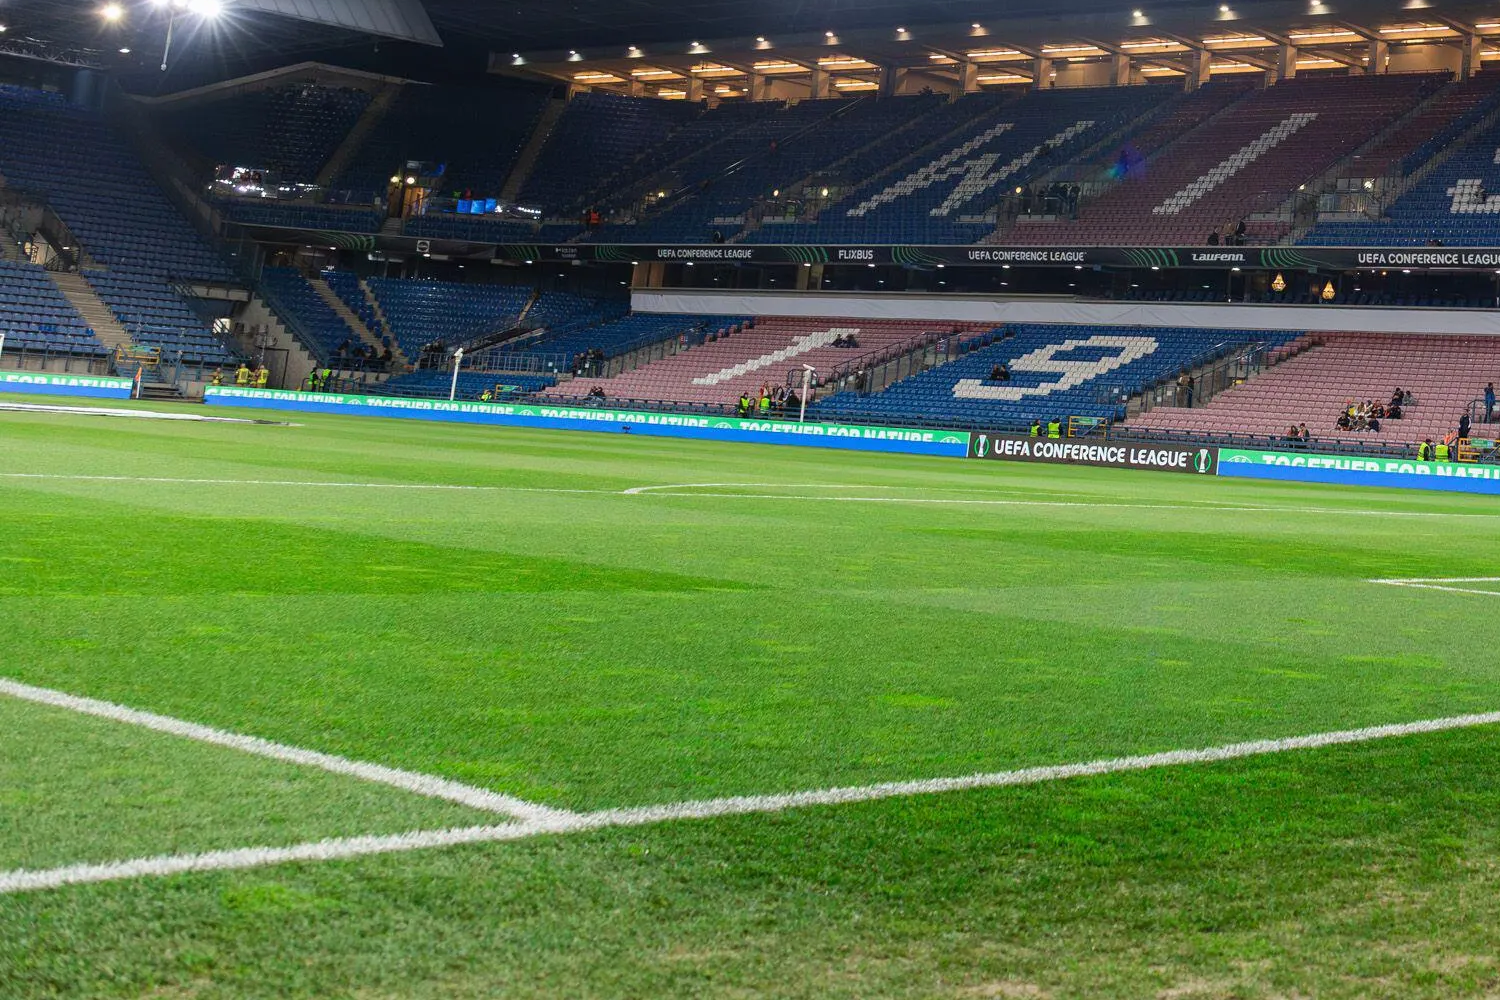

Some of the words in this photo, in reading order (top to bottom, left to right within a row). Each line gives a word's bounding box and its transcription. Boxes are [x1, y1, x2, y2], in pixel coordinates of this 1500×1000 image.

[657, 249, 676, 257] UEFA
[677, 249, 722, 258] CONFERENCE
[968, 250, 993, 261] UEFA
[996, 250, 1048, 261] CONFERENCE
[1050, 251, 1084, 262] LEAGUE
[1358, 253, 1386, 264] UEFA
[1389, 253, 1458, 265] CONFERENCE
[994, 440, 1030, 456] UEFA
[1033, 442, 1126, 462] CONFERENCE
